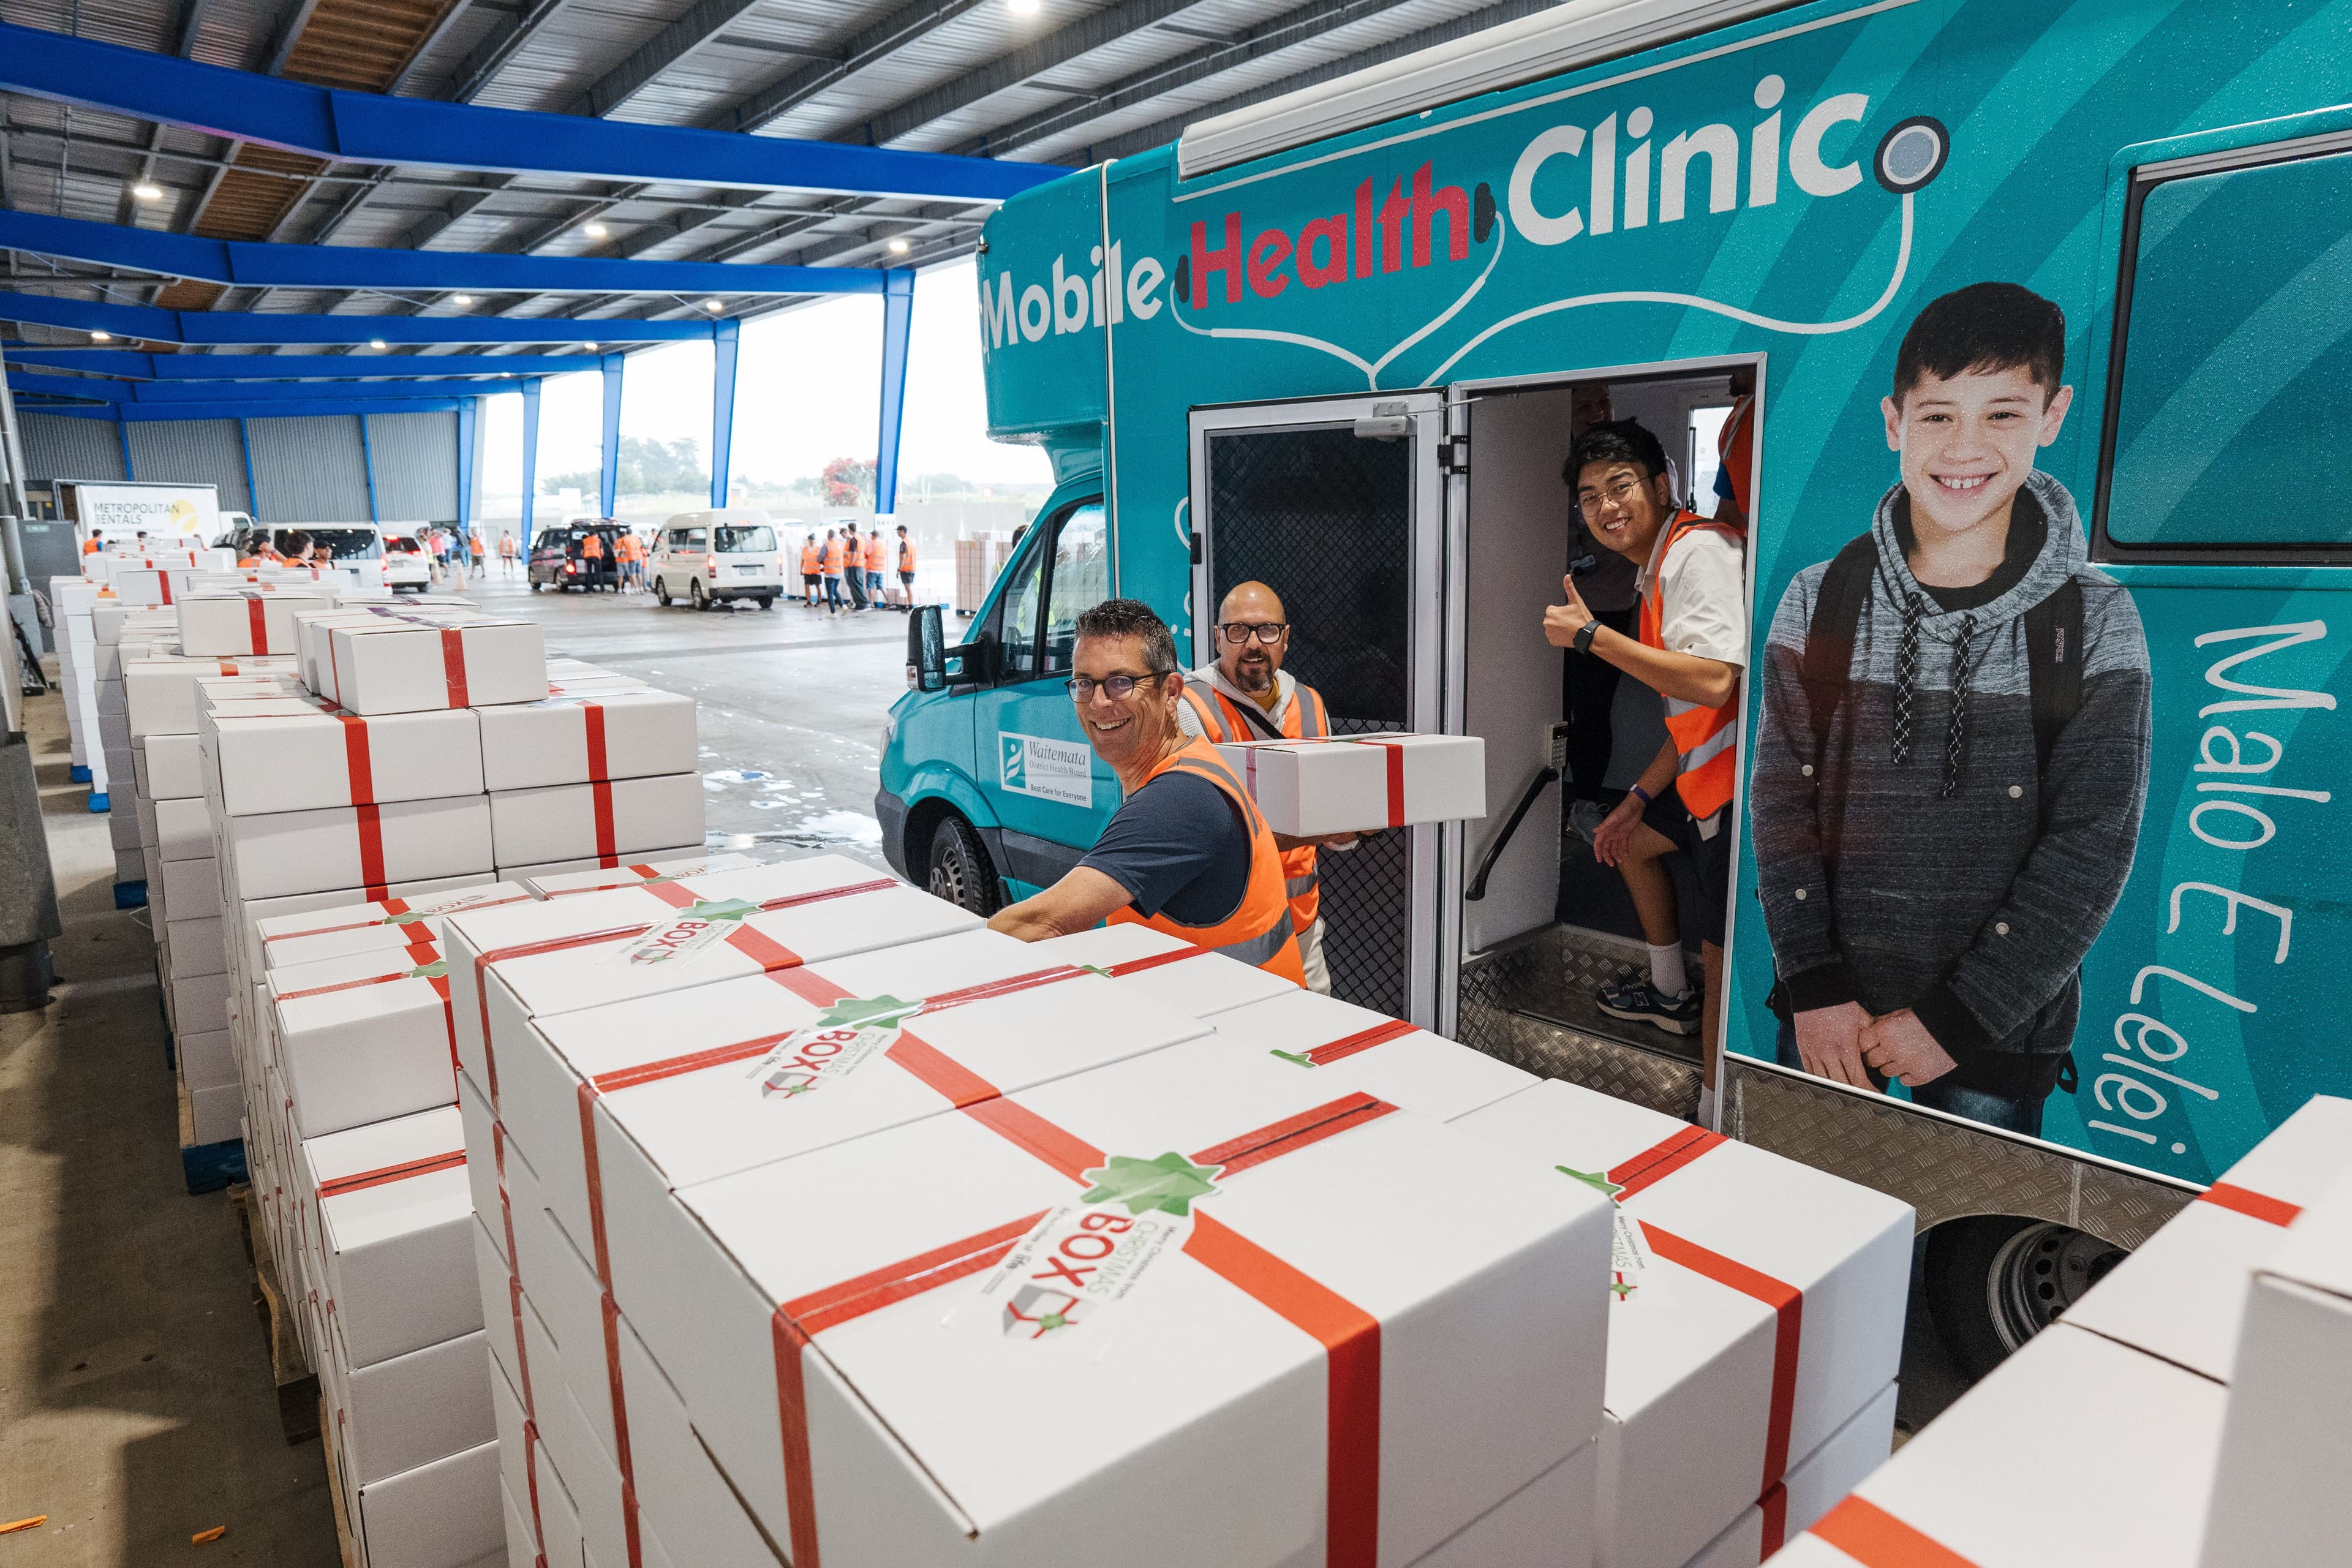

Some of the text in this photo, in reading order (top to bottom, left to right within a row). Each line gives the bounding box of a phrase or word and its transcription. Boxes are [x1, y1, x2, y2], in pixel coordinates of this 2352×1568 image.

[981, 74, 1870, 352] Mobile Health Clinic
[94, 502, 180, 514] METROPOLITAN
[94, 514, 143, 525] RENTALS
[1029, 741, 1086, 766] Waitemata
[1030, 760, 1087, 777] District Health Board
[1042, 786, 1054, 796] Care
[1063, 791, 1087, 802] Everyone
[2088, 619, 2337, 1155] Malo E Lelei
[647, 922, 710, 948] BOX
[782, 1030, 859, 1071] BOX
[1031, 1213, 1135, 1287] BOX
[1087, 1220, 1159, 1294] CHRISTMAS
